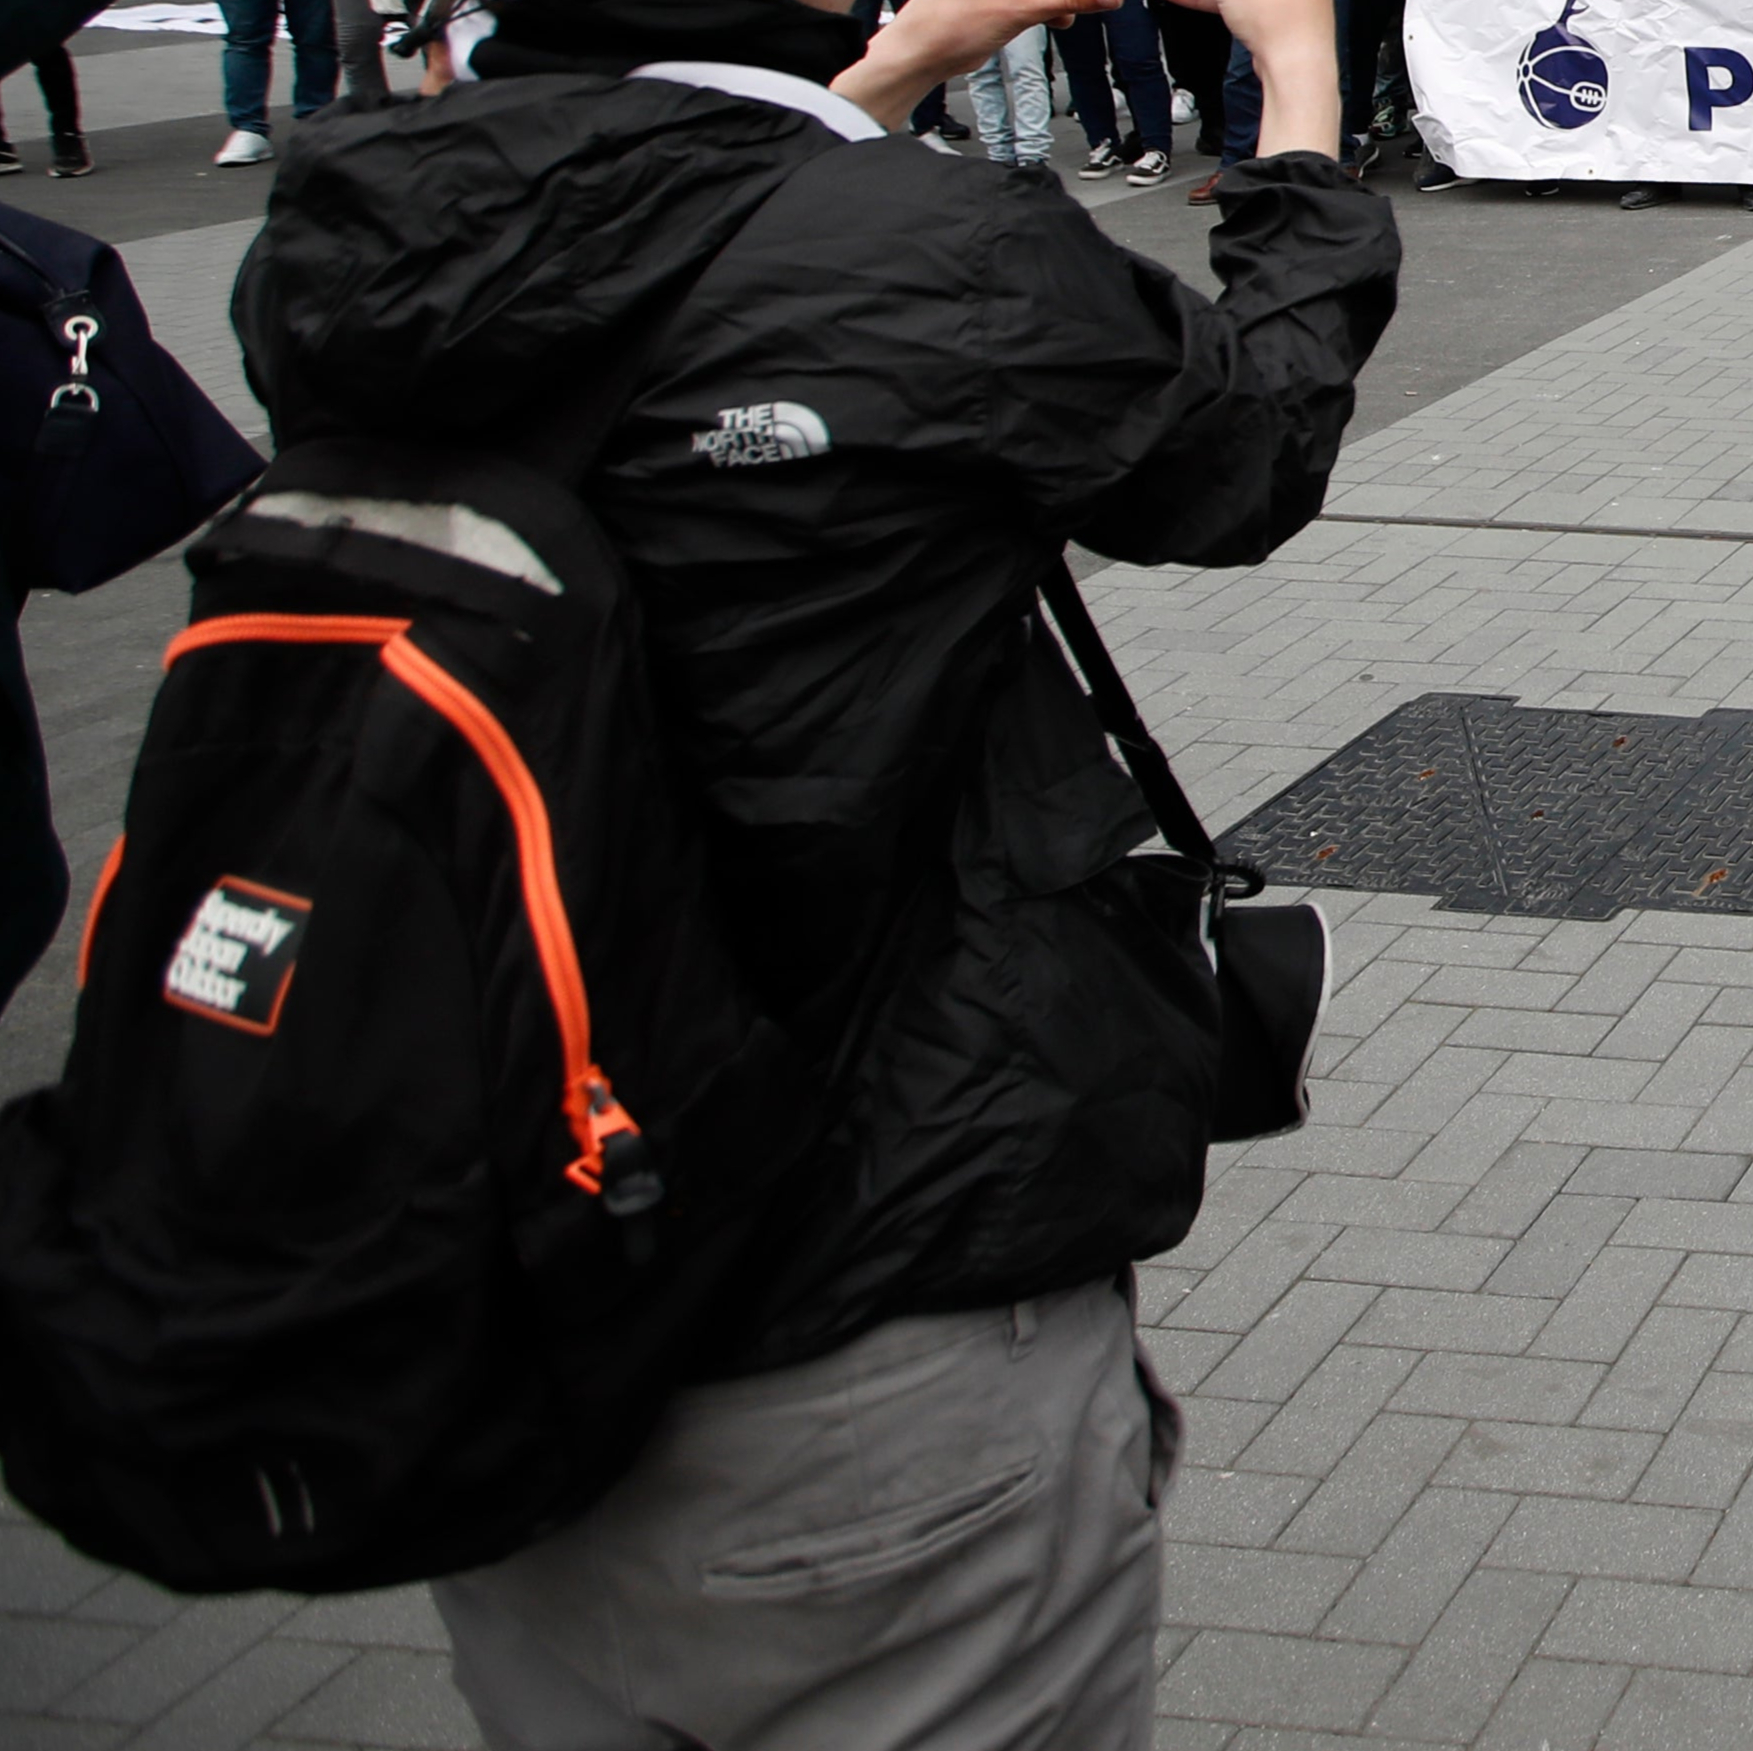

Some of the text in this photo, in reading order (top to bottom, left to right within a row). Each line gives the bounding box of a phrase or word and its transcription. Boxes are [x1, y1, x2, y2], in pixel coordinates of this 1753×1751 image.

[718, 402, 773, 429] THE
[692, 424, 775, 452] NORTH
[710, 443, 781, 468] FACE
